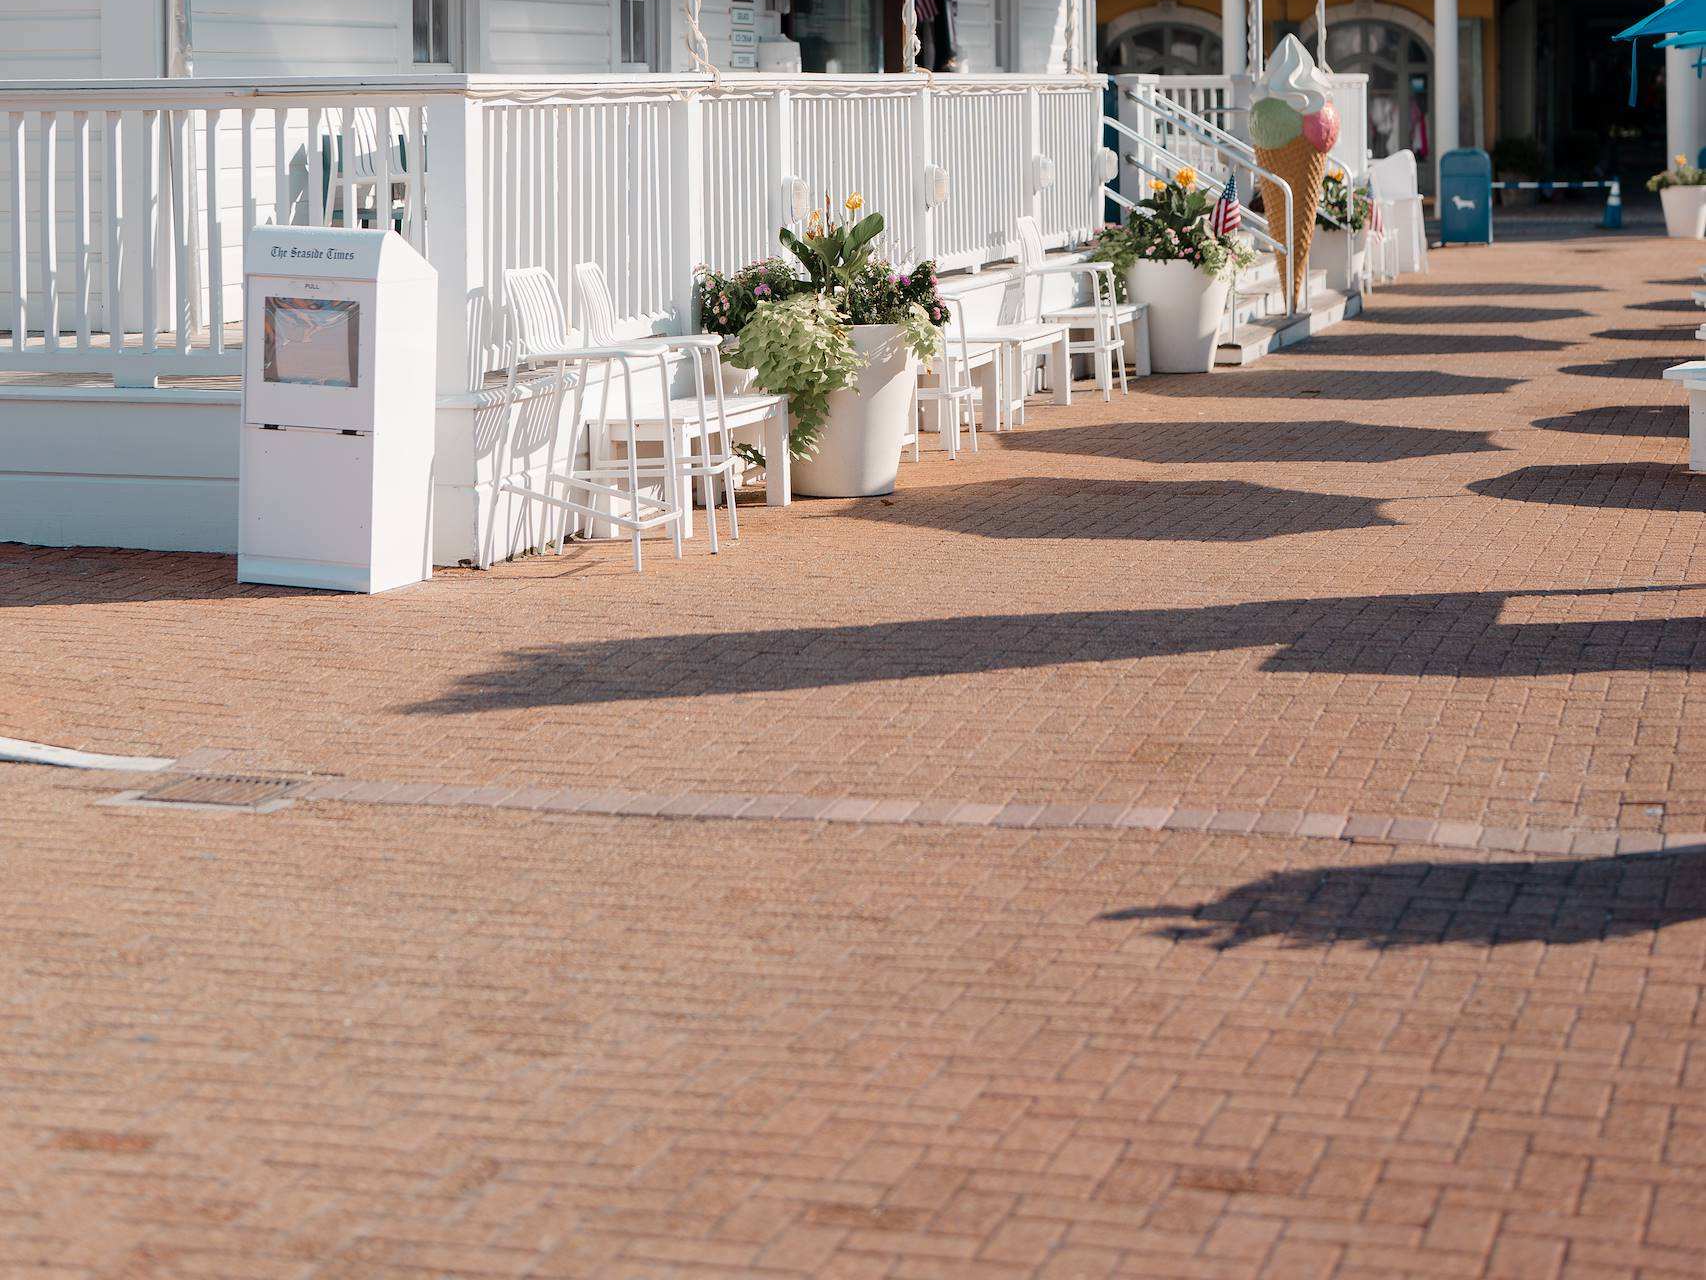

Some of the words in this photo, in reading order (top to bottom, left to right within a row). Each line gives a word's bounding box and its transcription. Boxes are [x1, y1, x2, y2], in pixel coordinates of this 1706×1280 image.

[271, 246, 288, 259] The
[290, 247, 323, 259] Seaside
[327, 248, 355, 260] Times
